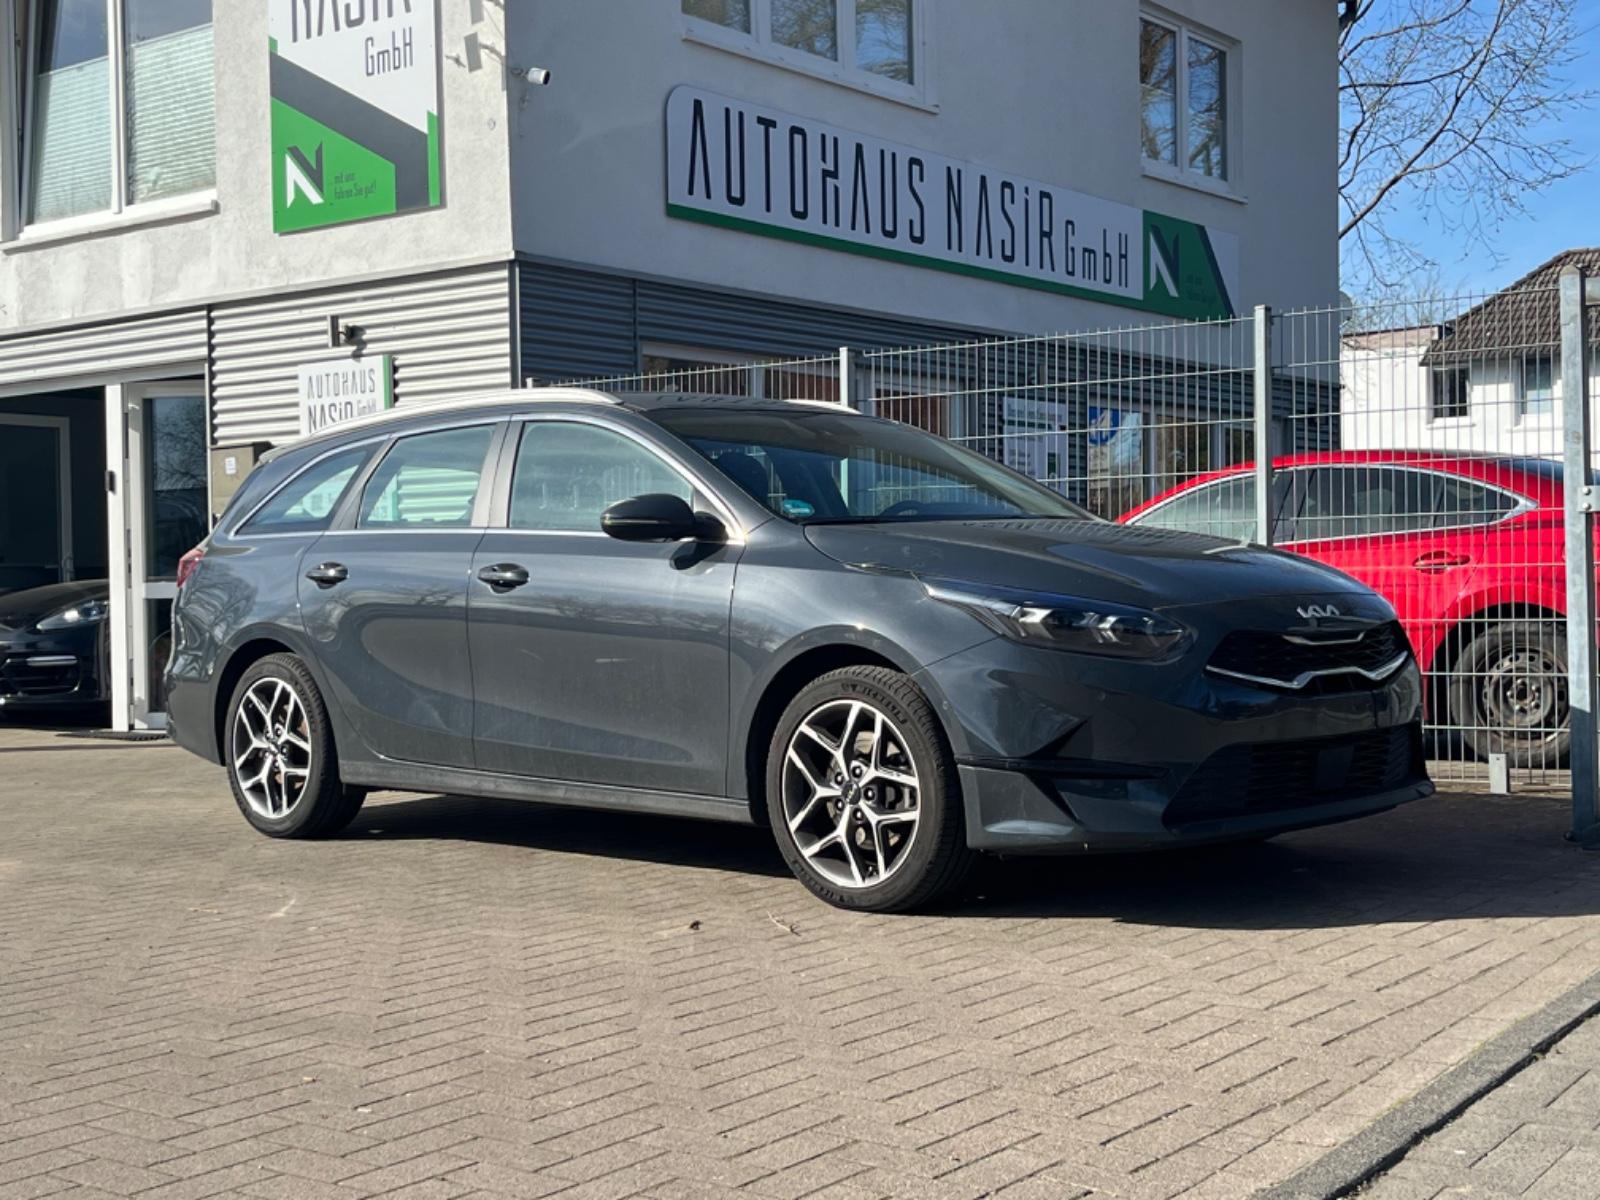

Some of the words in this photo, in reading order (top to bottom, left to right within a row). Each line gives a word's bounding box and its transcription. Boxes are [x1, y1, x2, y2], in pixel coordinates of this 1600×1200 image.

[365, 26, 413, 76] GmbH
[688, 98, 925, 245] AUTOHAUS
[1065, 219, 1128, 288] GmbH
[307, 368, 375, 400] AUTOHAUS
